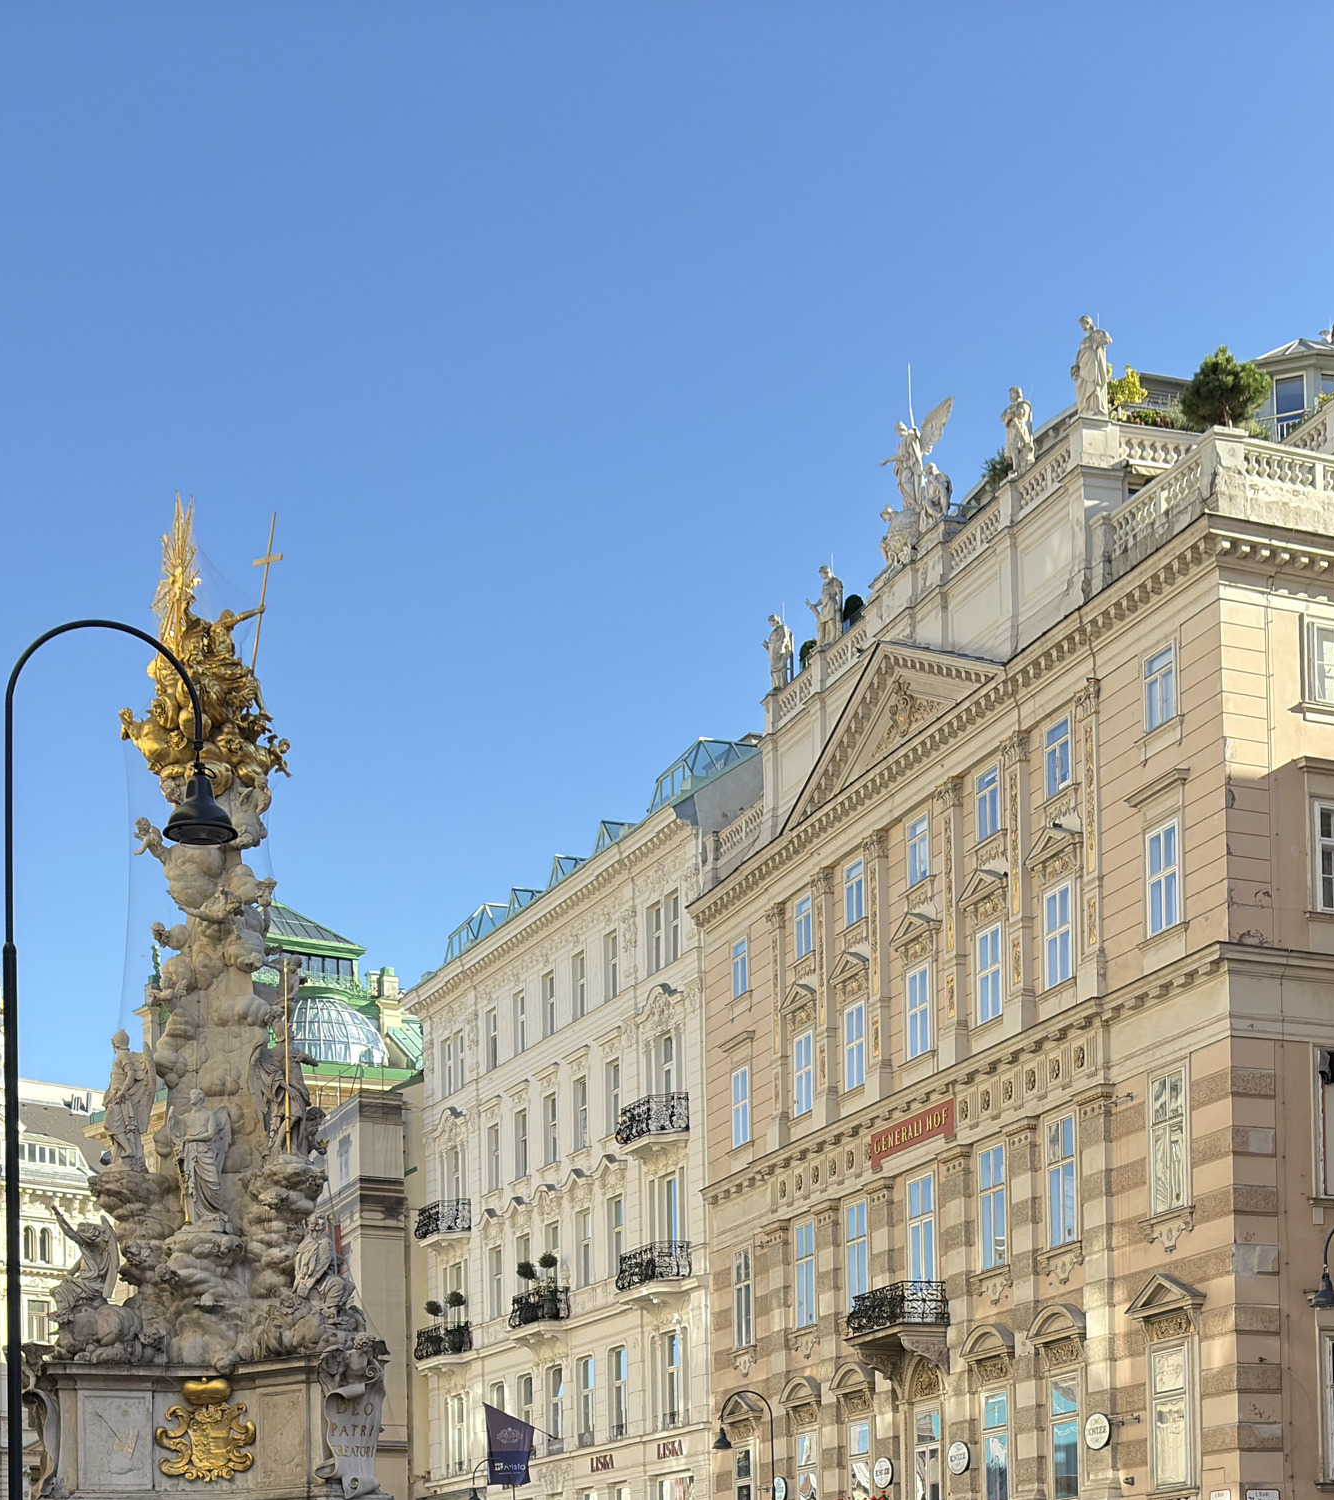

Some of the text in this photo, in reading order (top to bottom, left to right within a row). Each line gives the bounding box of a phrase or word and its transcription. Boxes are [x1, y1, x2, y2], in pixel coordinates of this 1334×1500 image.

[873, 1107, 949, 1155] GENERALI HOF
[336, 1398, 374, 1416] DEO
[331, 1422, 375, 1437] PATRI
[657, 1439, 684, 1460] LISKA
[590, 1453, 615, 1473] LISKA
